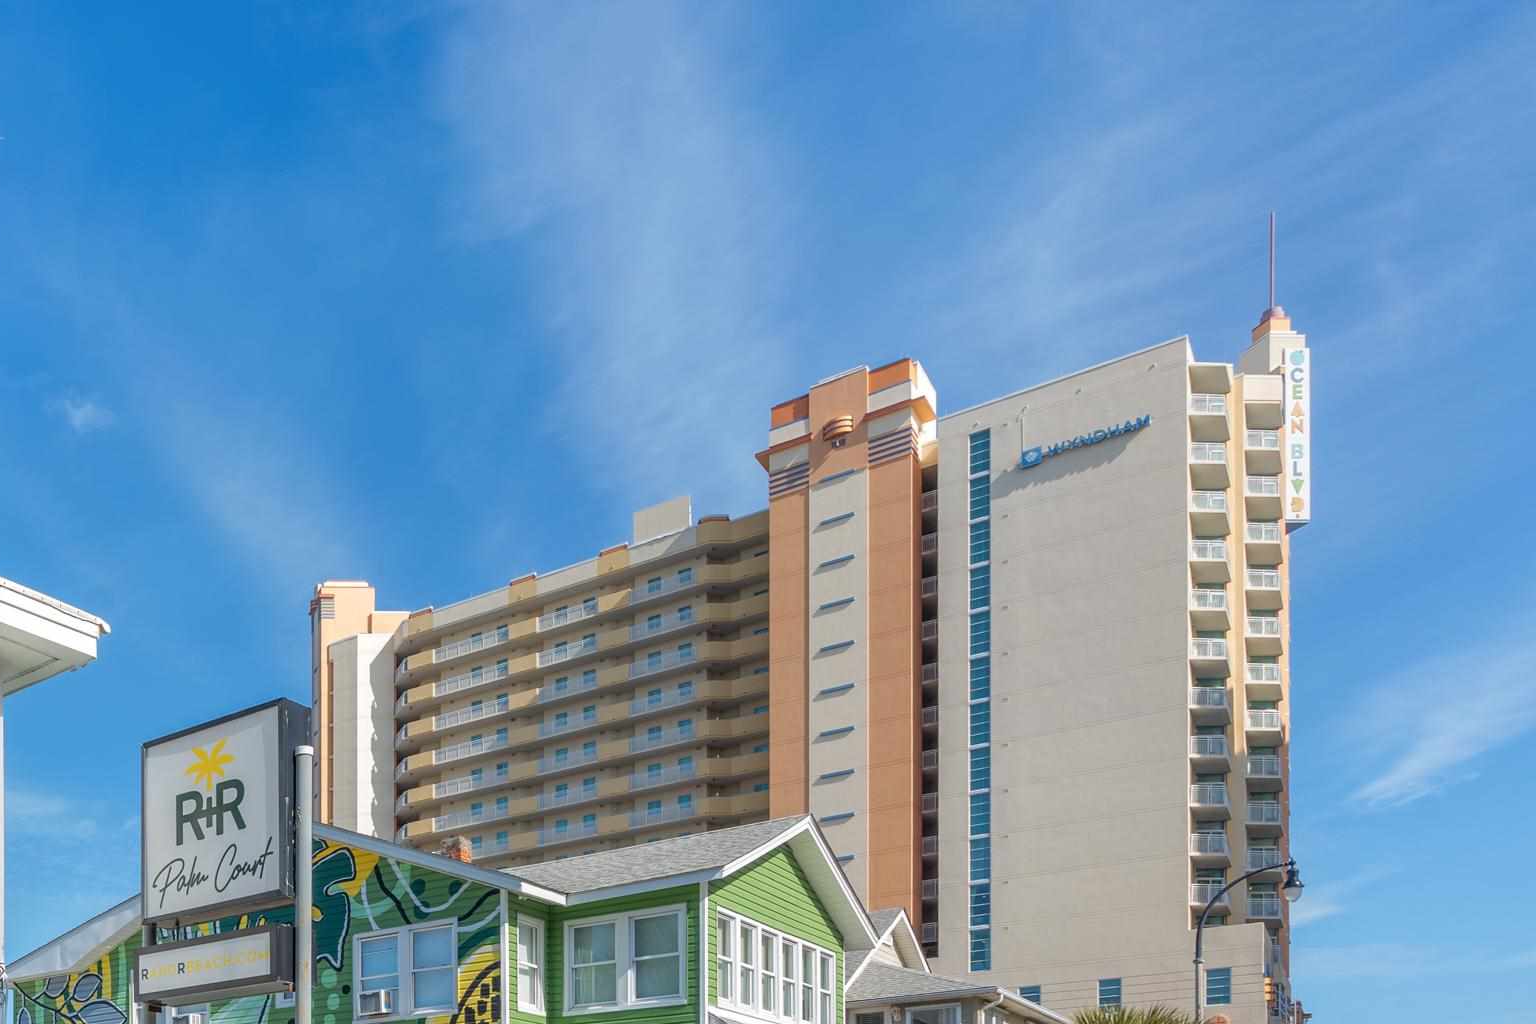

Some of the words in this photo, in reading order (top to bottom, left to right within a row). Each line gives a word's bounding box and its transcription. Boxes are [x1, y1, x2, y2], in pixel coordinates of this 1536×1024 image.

[1048, 414, 1151, 456] WYNDHAM
[152, 855, 209, 909] Palm
[214, 836, 275, 893] Court
